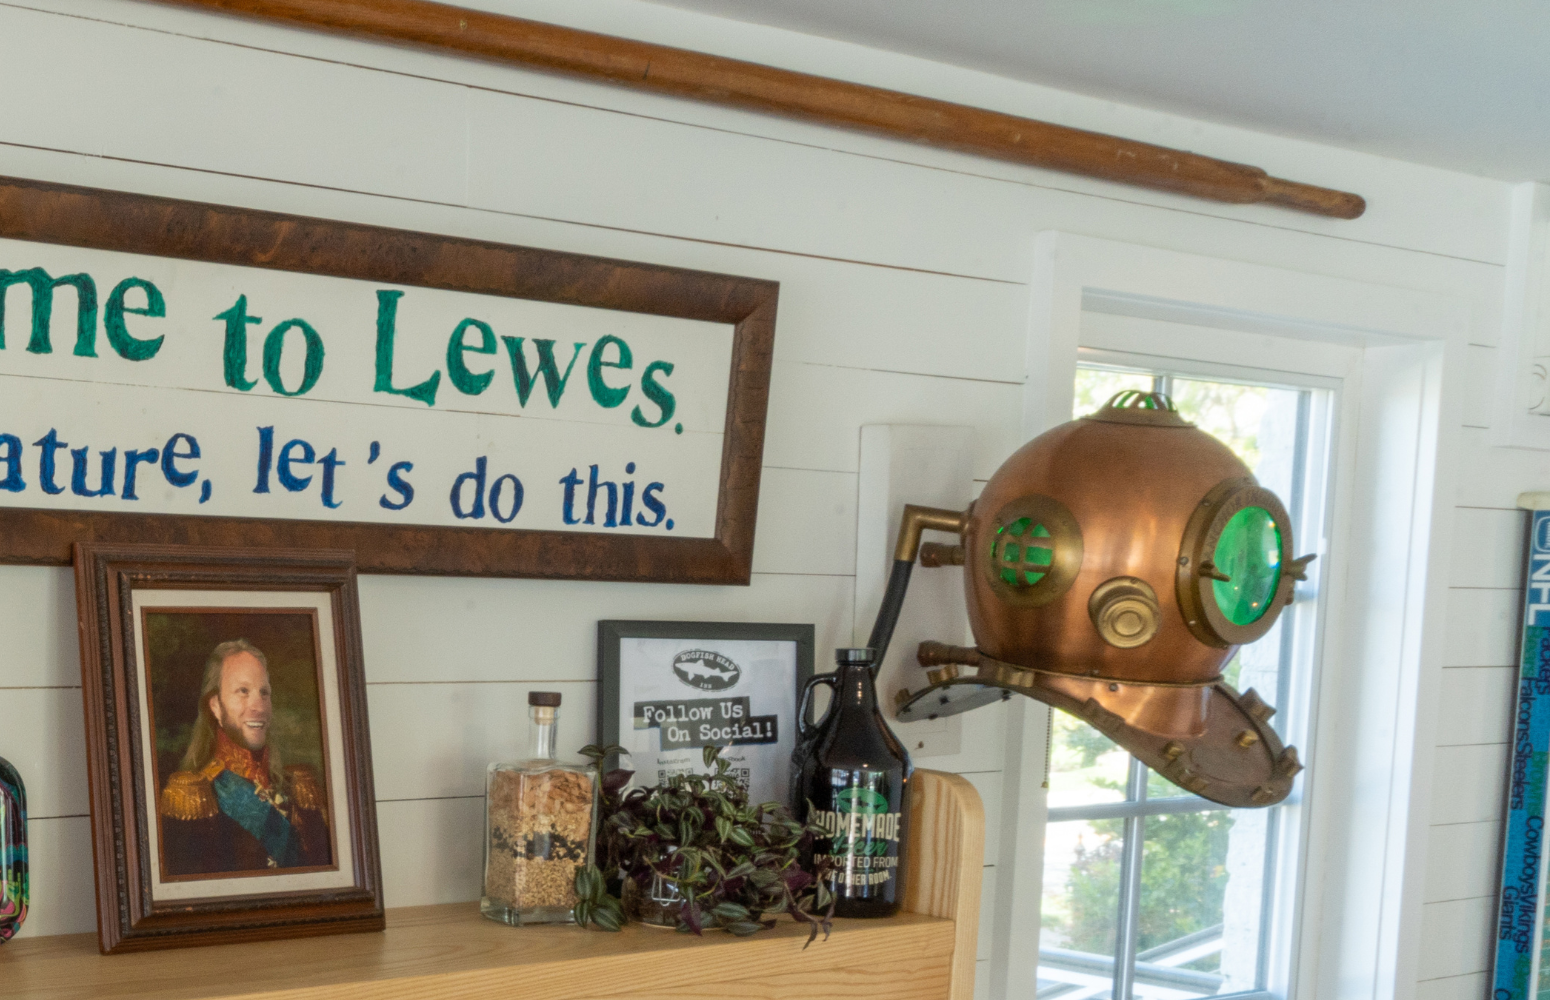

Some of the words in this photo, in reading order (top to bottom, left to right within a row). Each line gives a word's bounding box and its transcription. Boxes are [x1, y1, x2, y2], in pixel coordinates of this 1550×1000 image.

[213, 294, 326, 396] to
[374, 290, 684, 435] Lewes.
[450, 457, 524, 524] do
[560, 463, 675, 531] this.
[681, 651, 715, 661] DOGFISH
[716, 655, 735, 670] HEAD
[642, 705, 714, 723] Follow
[719, 702, 743, 718] Us
[667, 726, 691, 742] On
[699, 722, 773, 741] Social!
[1516, 677, 1538, 741] Falcons
[1511, 741, 1534, 811] Steelers
[838, 872, 866, 885] OHER
[873, 856, 899, 868] FROM
[1519, 814, 1545, 895] Cowboys
[1499, 885, 1521, 941] Giants
[1513, 894, 1539, 955] Vikings
